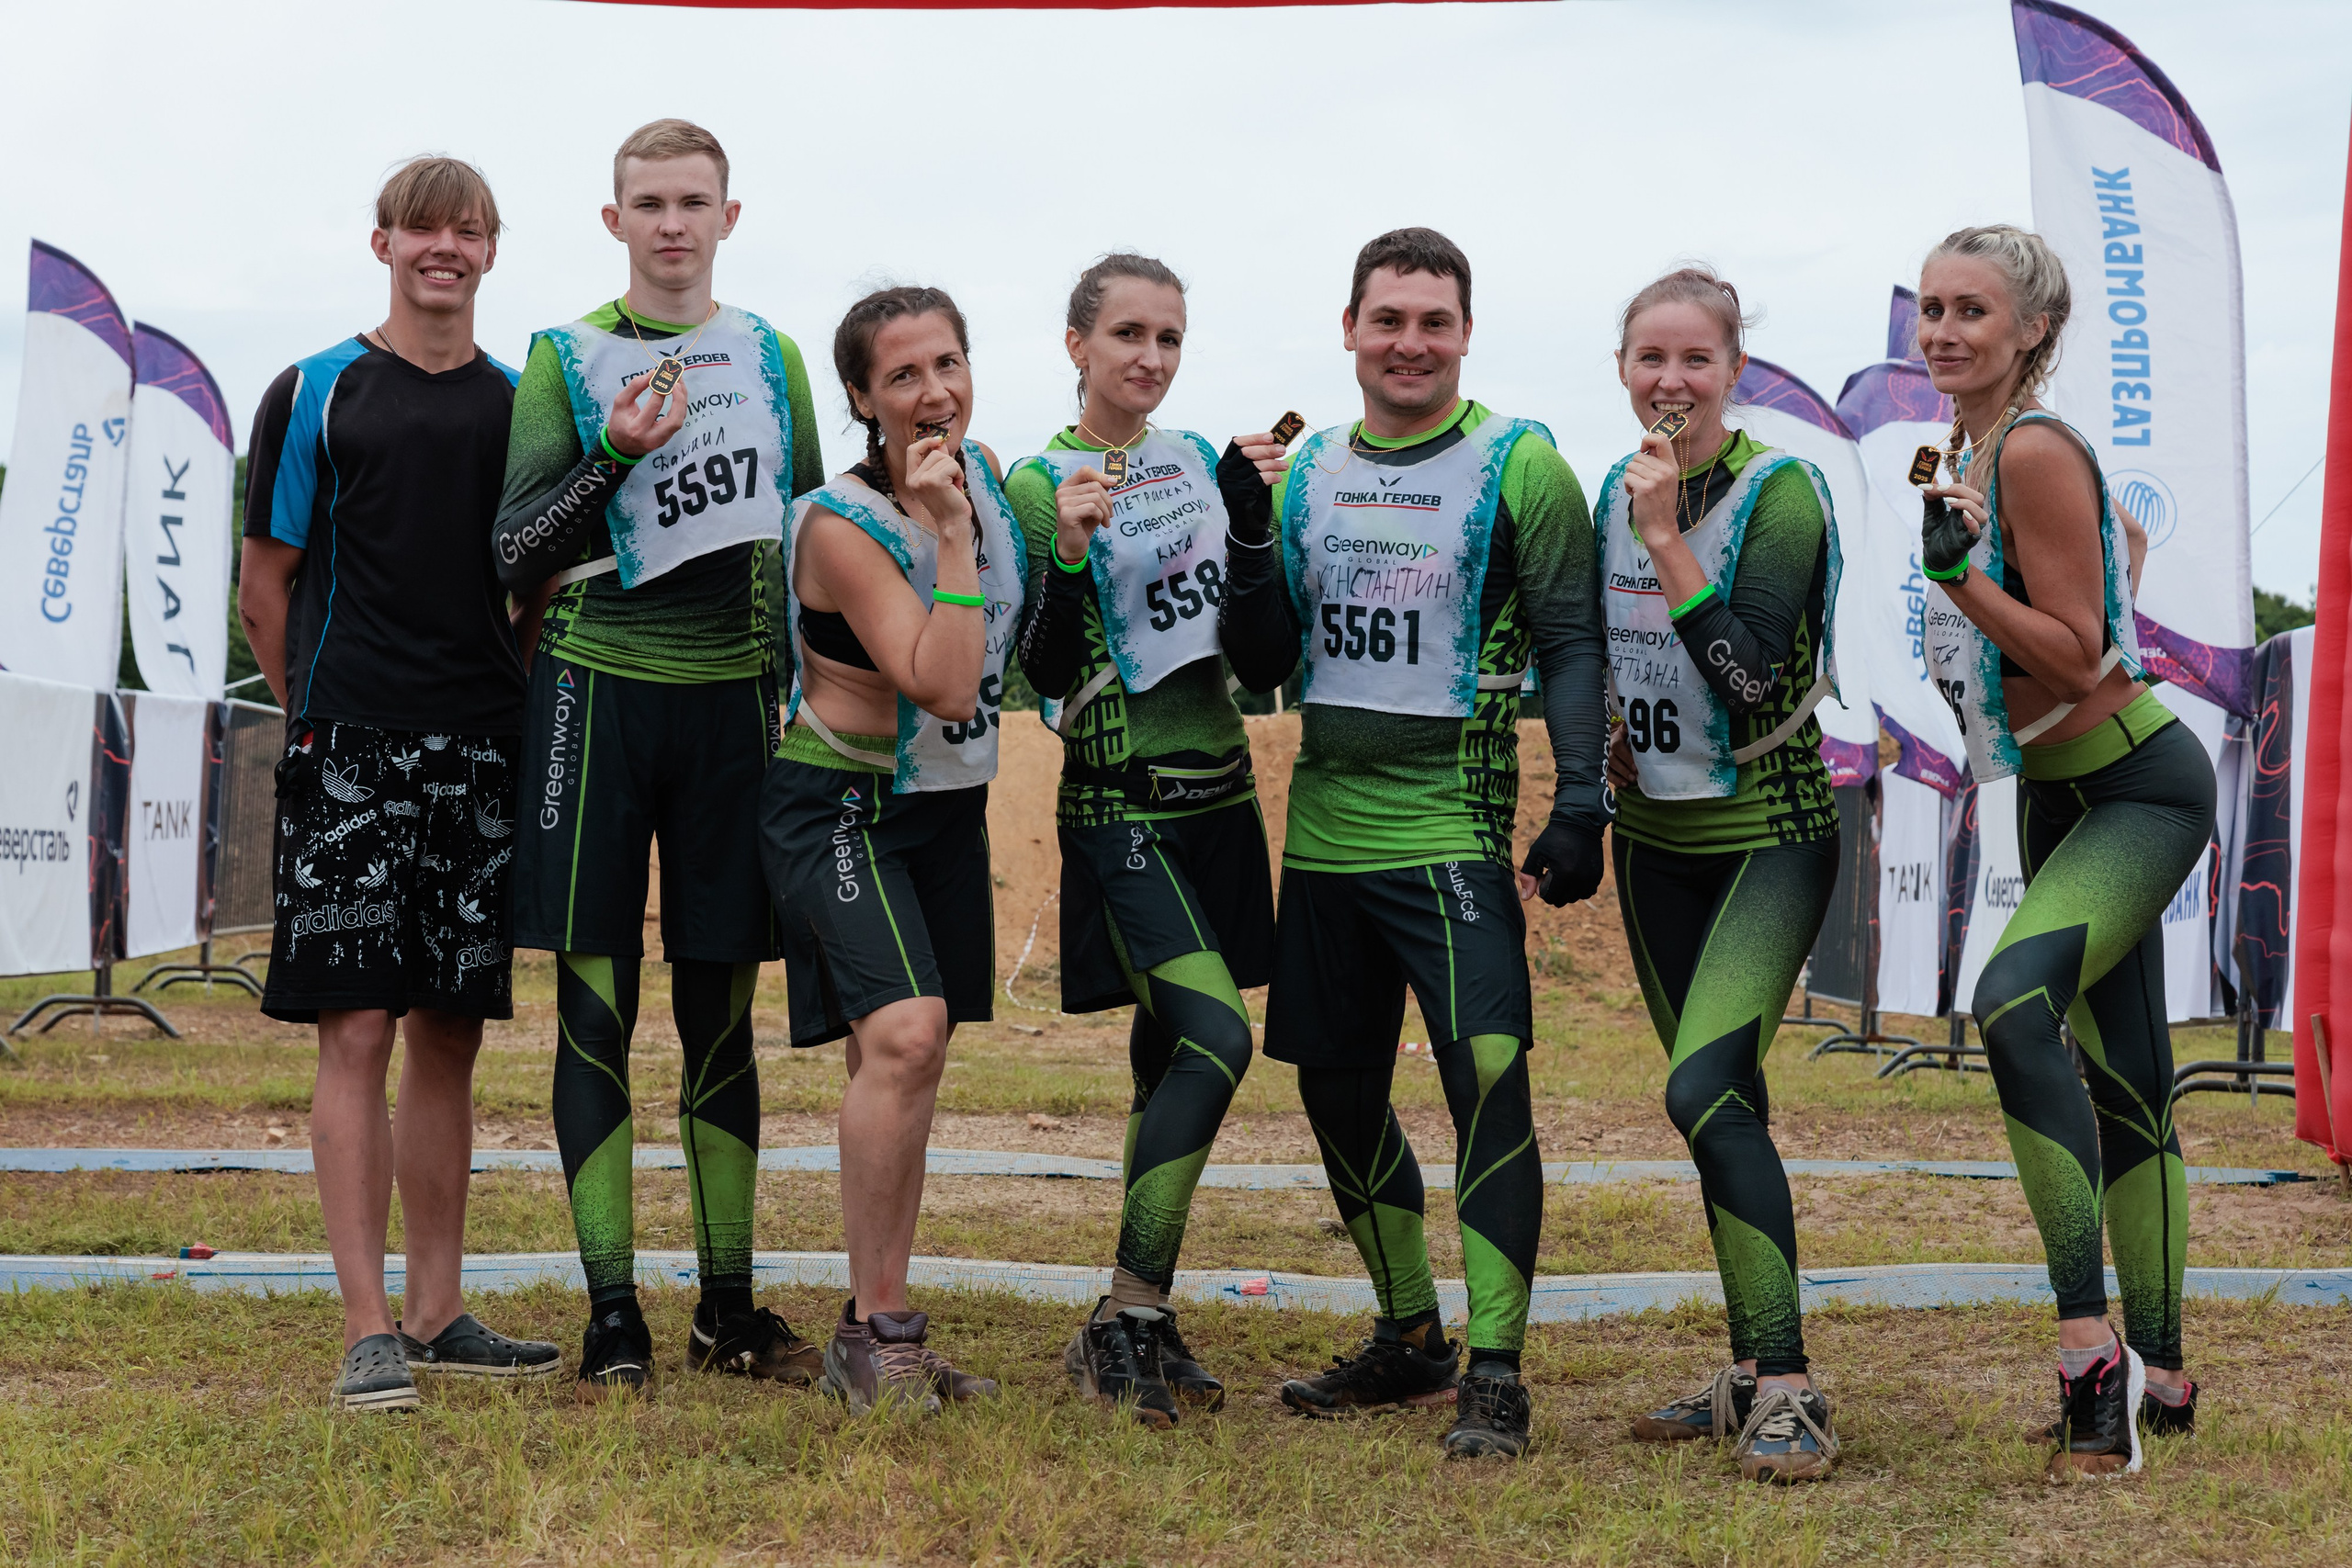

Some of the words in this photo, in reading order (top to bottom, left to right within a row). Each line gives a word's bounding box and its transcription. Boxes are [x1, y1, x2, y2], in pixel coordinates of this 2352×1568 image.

[677, 353, 731, 367] ЕРОЕВ
[654, 447, 759, 529] 5597
[1145, 464, 1182, 479] ГЕРОЕВ
[1913, 473, 1928, 482] 2025
[499, 465, 607, 565] Greenway
[1119, 499, 1203, 537] Greenway
[1334, 491, 1378, 504] ГОНКА
[1383, 491, 1442, 508] ГЕРОЕВ
[548, 499, 598, 552] GLOBAL
[1156, 533, 1193, 565] КАТЯ
[1323, 534, 1424, 559] Geenway
[1347, 556, 1397, 566] GLOBAL
[1146, 558, 1224, 632] 558
[1317, 563, 1452, 605] КНСТАНТИН
[1320, 603, 1420, 666] 5561
[540, 687, 576, 829] Greenway
[567, 720, 581, 785] GLOBAL
[1185, 779, 1236, 800] DEMIX
[141, 800, 193, 841] TANK
[323, 808, 378, 843] adidas
[2165, 871, 2201, 925] БАНК
[291, 900, 396, 938] adidas
